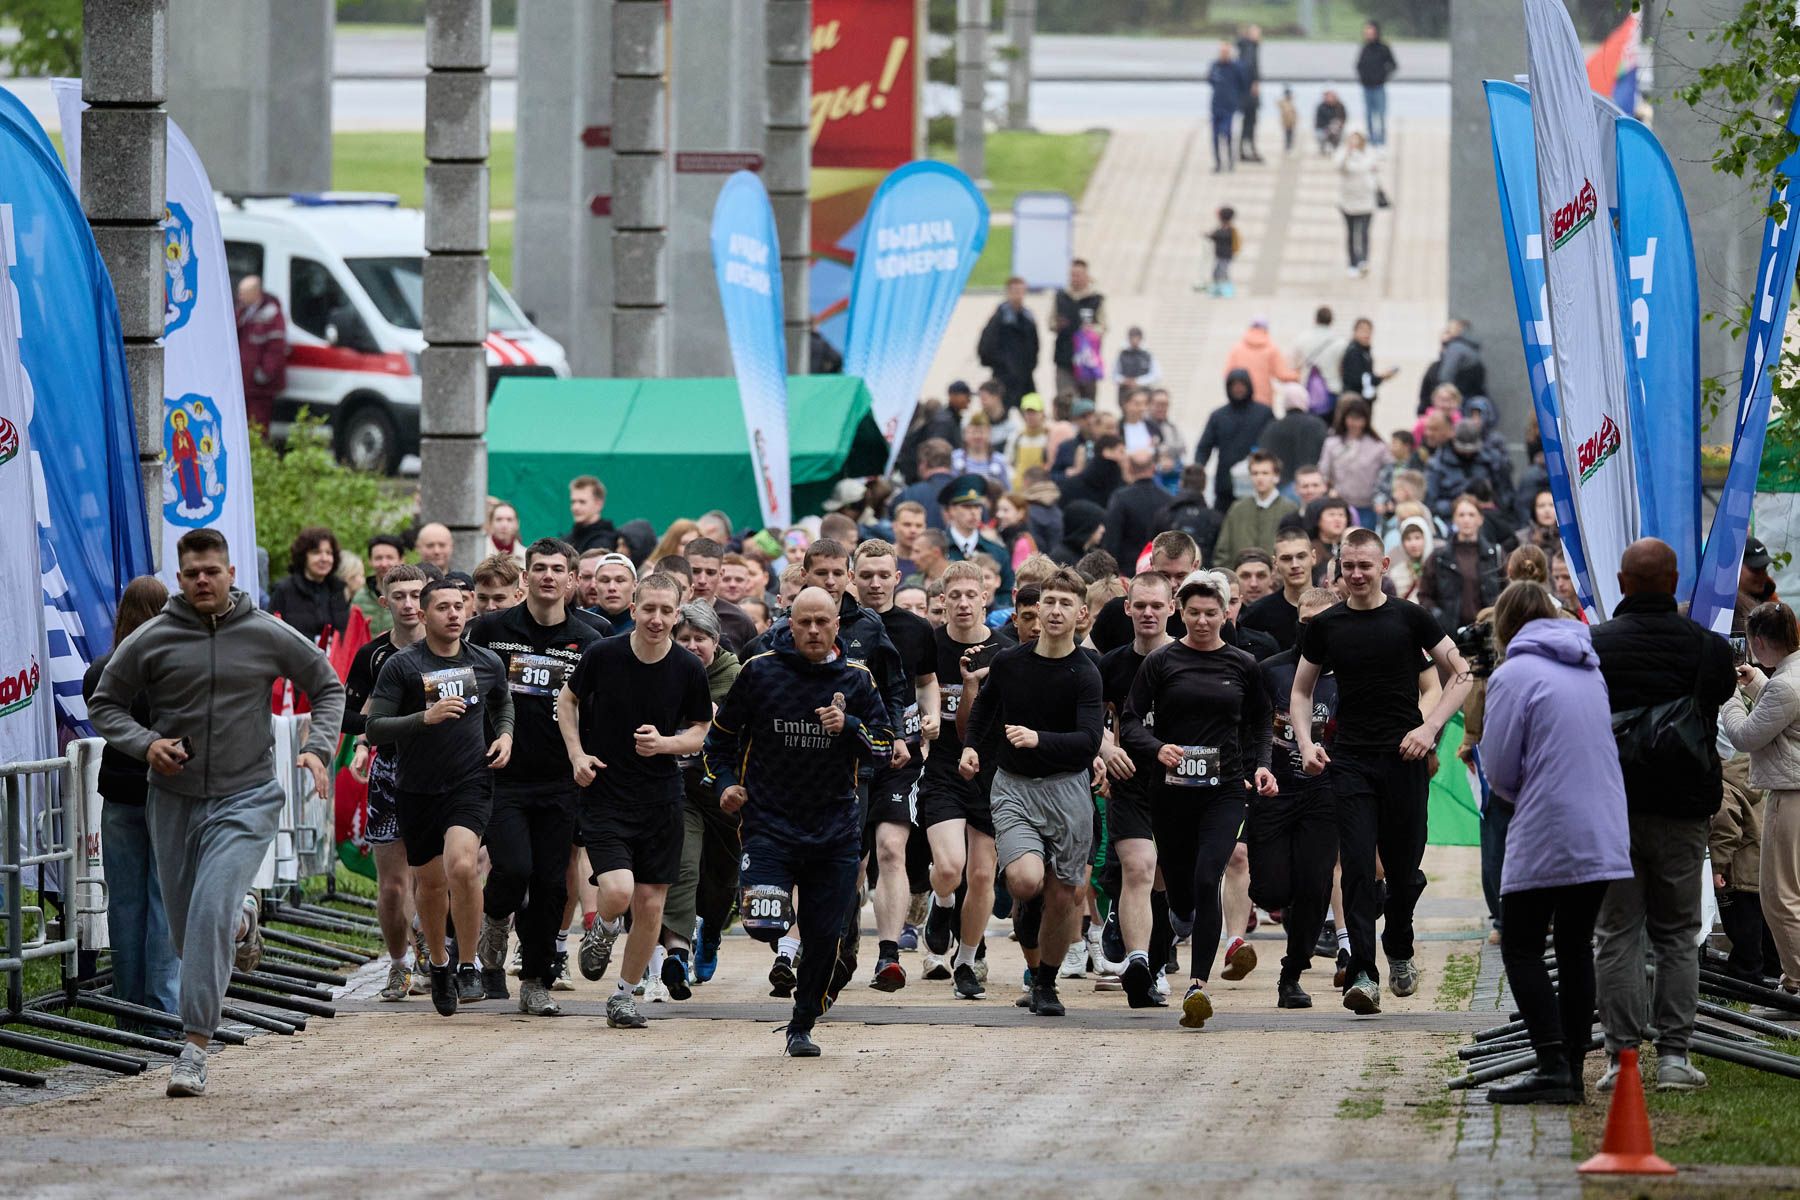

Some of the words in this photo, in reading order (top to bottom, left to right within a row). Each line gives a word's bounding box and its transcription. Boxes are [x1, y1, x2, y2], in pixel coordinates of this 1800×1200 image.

[522, 667, 550, 686] 319
[438, 680, 464, 698] 307
[785, 735, 798, 747] FLY
[801, 736, 831, 749] BETTER
[1177, 759, 1207, 776] 306
[751, 899, 781, 918] 308
